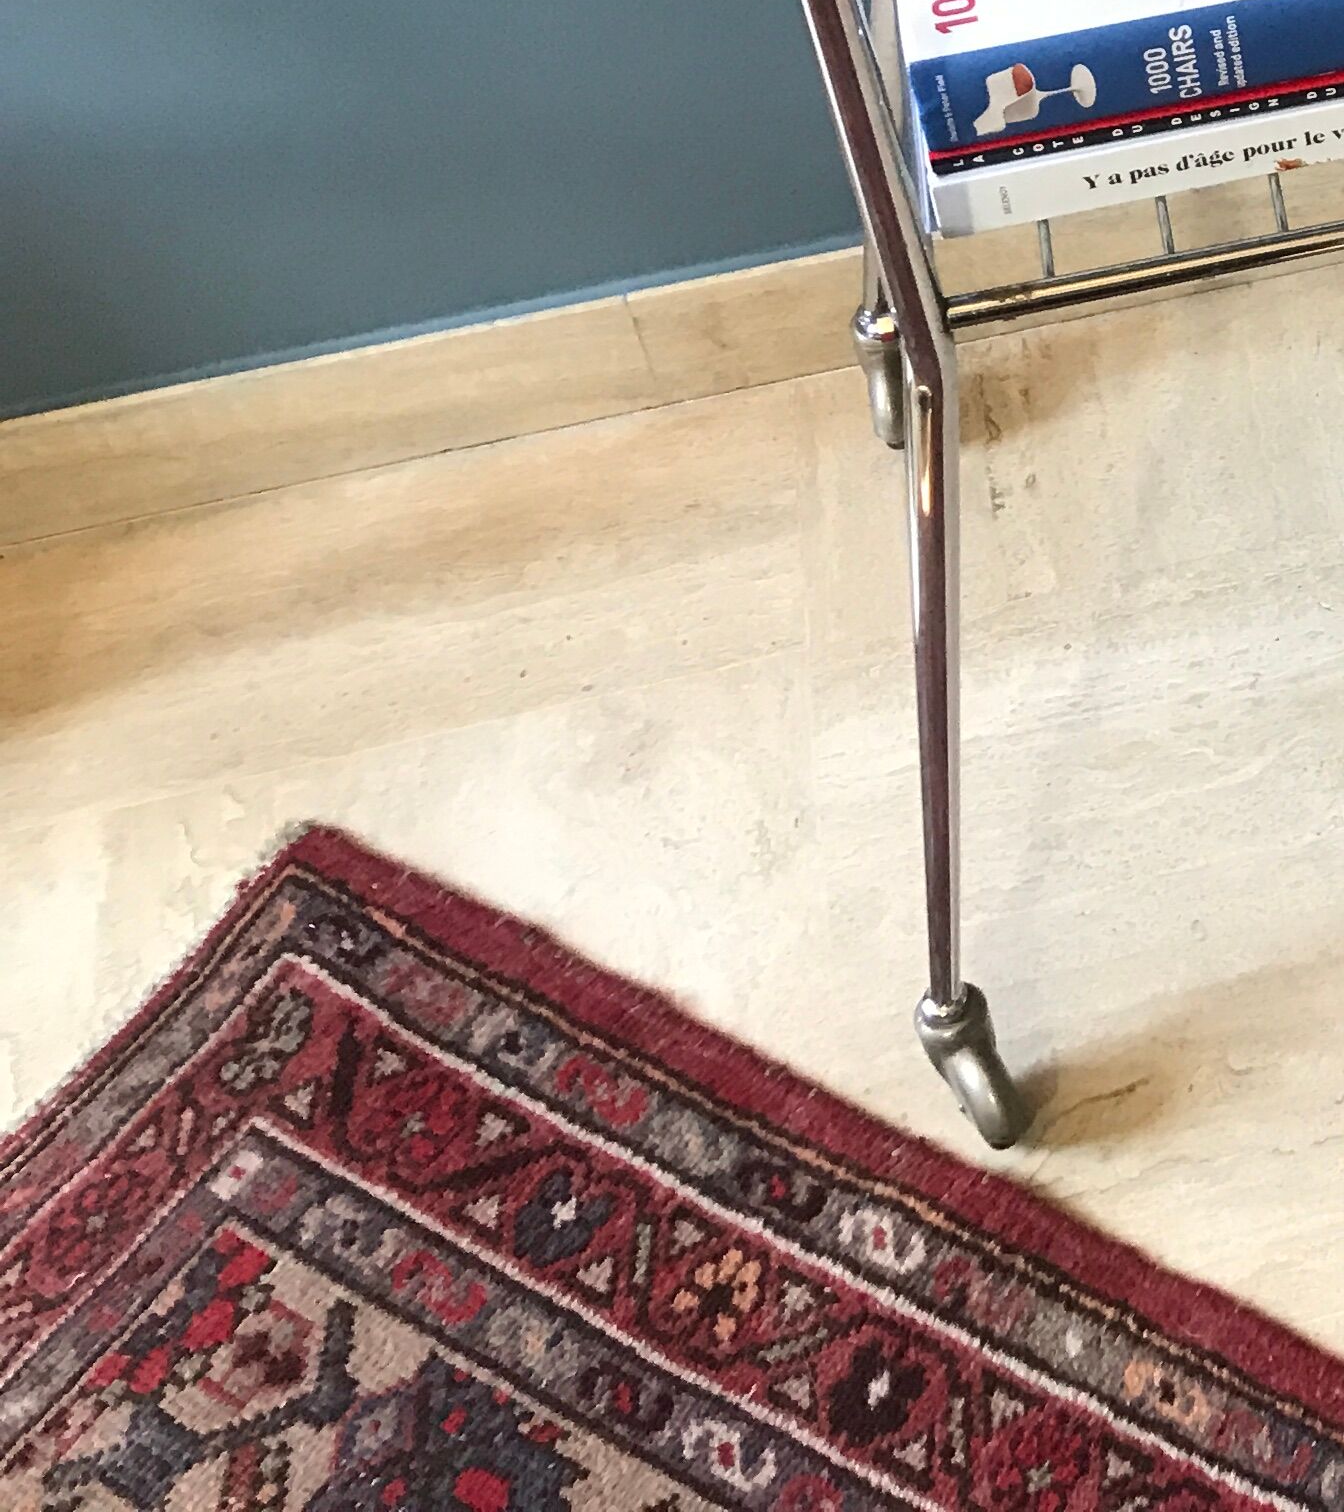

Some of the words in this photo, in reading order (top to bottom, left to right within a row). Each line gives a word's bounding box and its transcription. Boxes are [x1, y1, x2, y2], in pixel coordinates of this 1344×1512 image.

[1210, 29, 1224, 49] and
[1226, 15, 1240, 53] edition
[1143, 47, 1172, 94] 1000
[1168, 24, 1202, 98] CHAIRS
[953, 154, 985, 167] LA
[1112, 124, 1144, 138] DU
[1171, 98, 1279, 126] DESIGN
[1306, 87, 1337, 100] DU
[1083, 174, 1099, 190] Y
[1108, 172, 1122, 185] a
[1129, 161, 1170, 184] pas
[1176, 149, 1235, 172] d'âge
[1243, 137, 1297, 162] pour
[1305, 130, 1325, 146] le
